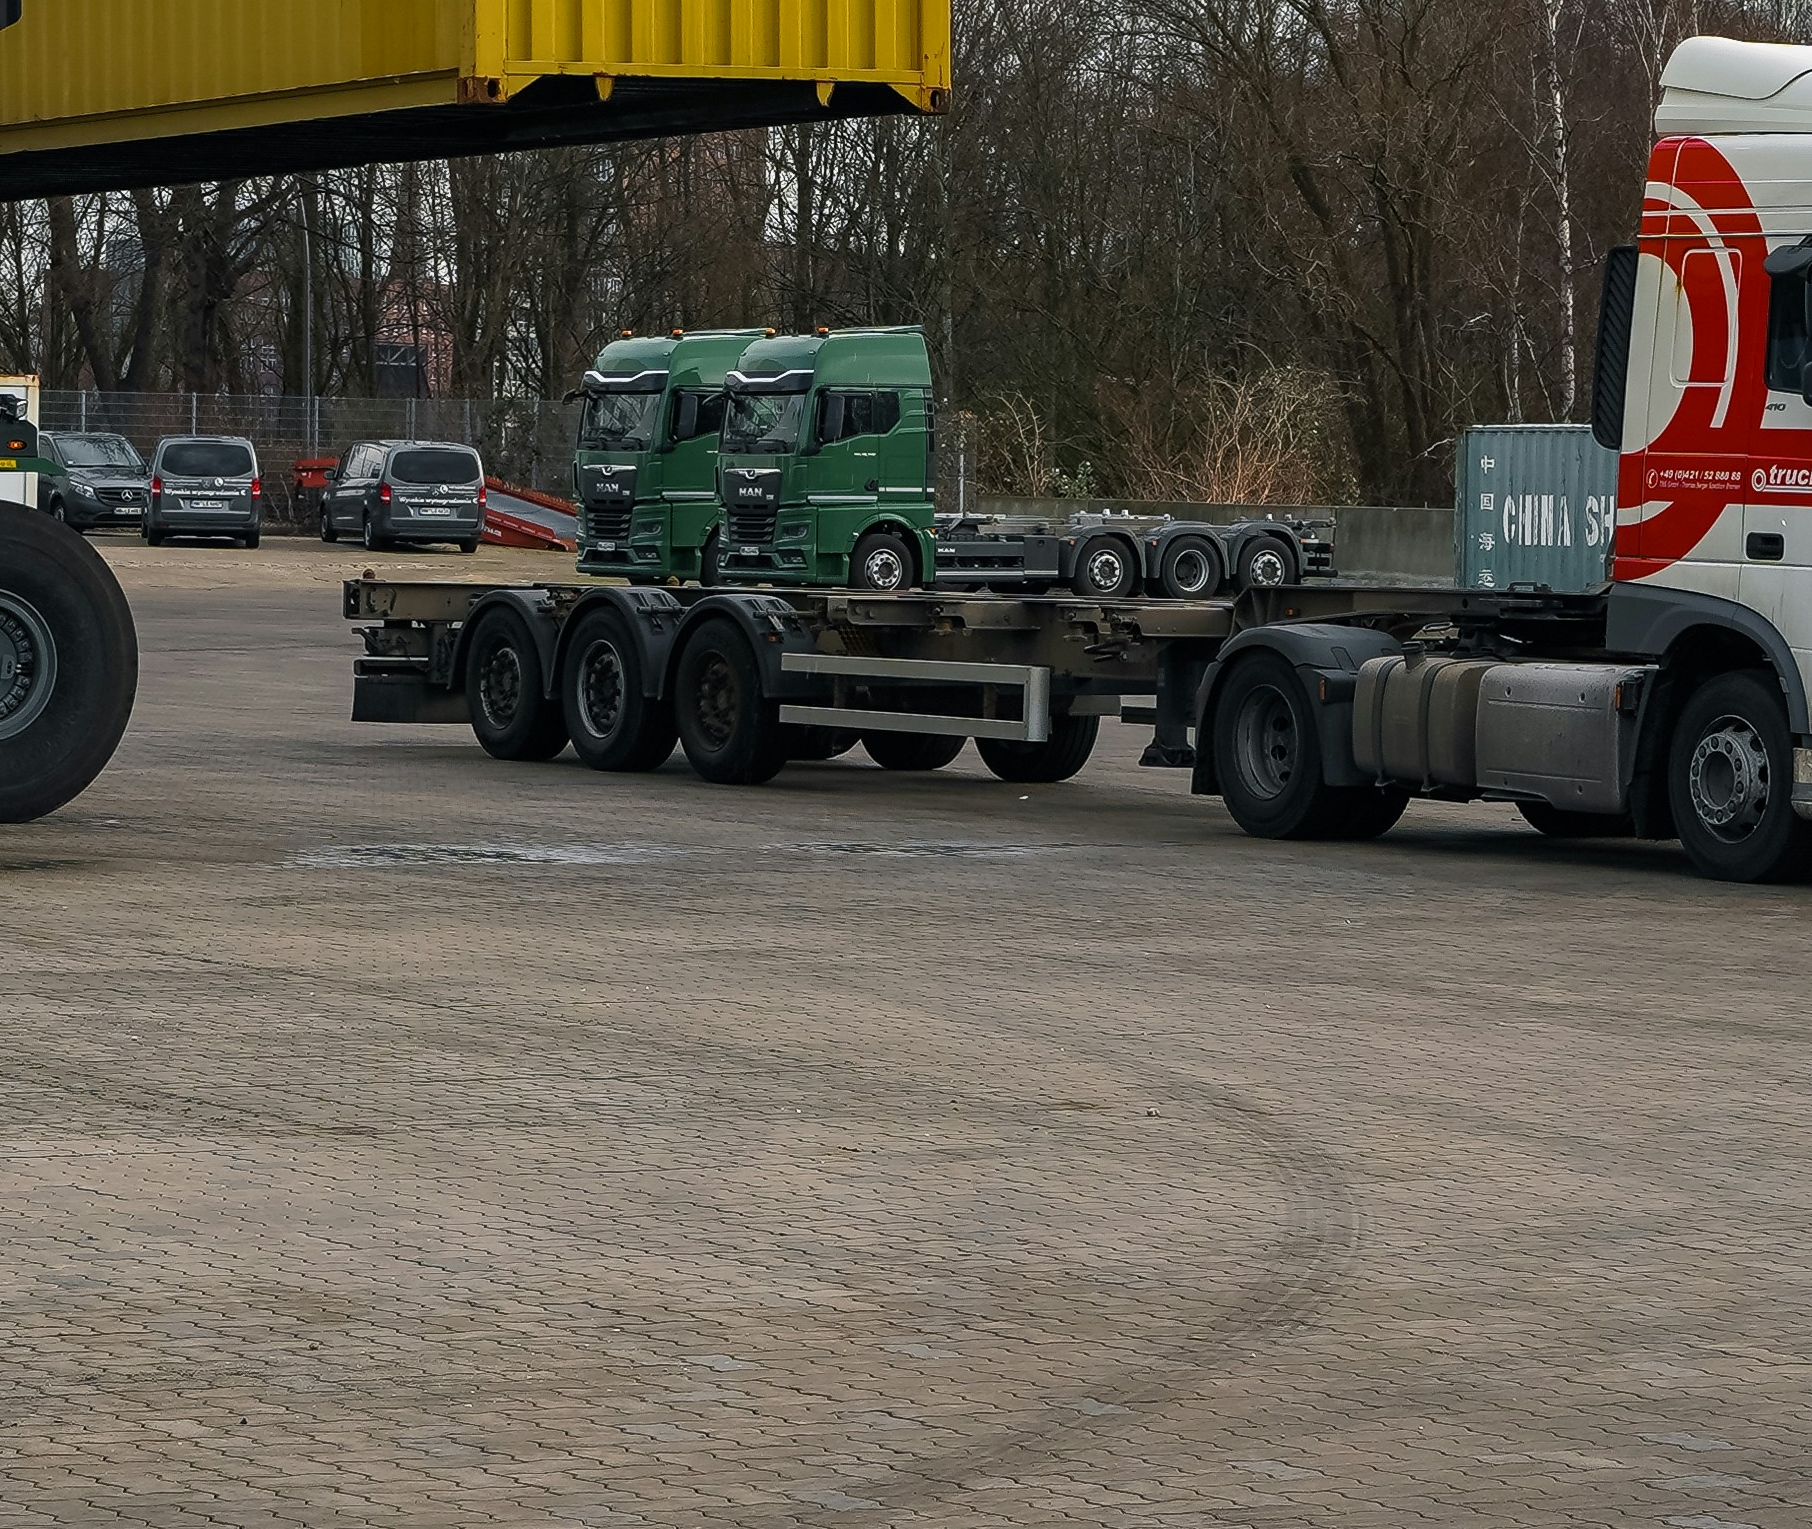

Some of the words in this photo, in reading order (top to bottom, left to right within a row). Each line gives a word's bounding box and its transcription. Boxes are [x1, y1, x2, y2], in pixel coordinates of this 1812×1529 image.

[1660, 469, 1674, 479] +49
[596, 483, 619, 493] MAN
[739, 487, 763, 497] MAN
[1502, 494, 1572, 547] CHINA
